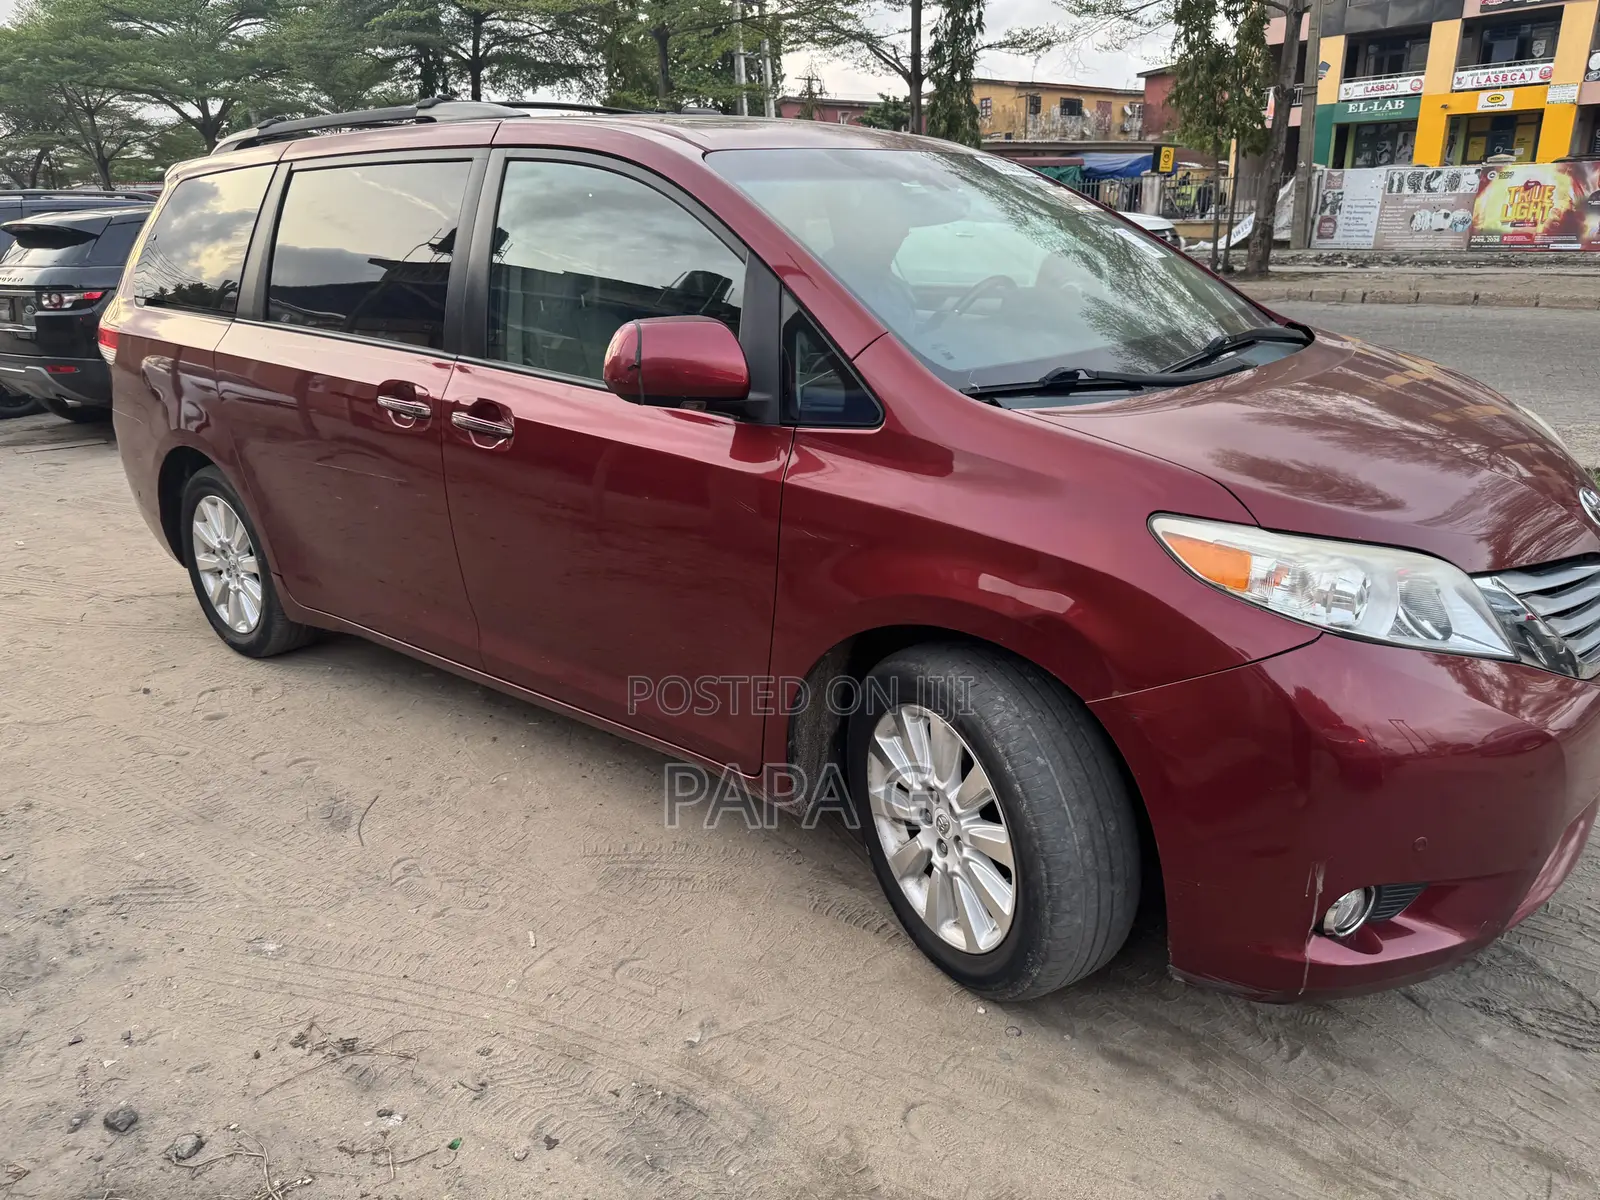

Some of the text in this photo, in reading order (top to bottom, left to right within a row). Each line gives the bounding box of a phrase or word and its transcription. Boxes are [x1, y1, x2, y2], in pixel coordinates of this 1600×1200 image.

[1471, 70, 1534, 86] (LASBCA)
[1364, 83, 1399, 94] (LASBCA)
[1347, 99, 1405, 114] EL-LAB
[1507, 184, 1556, 206] TRUE
[1500, 202, 1553, 223] LIGHT
